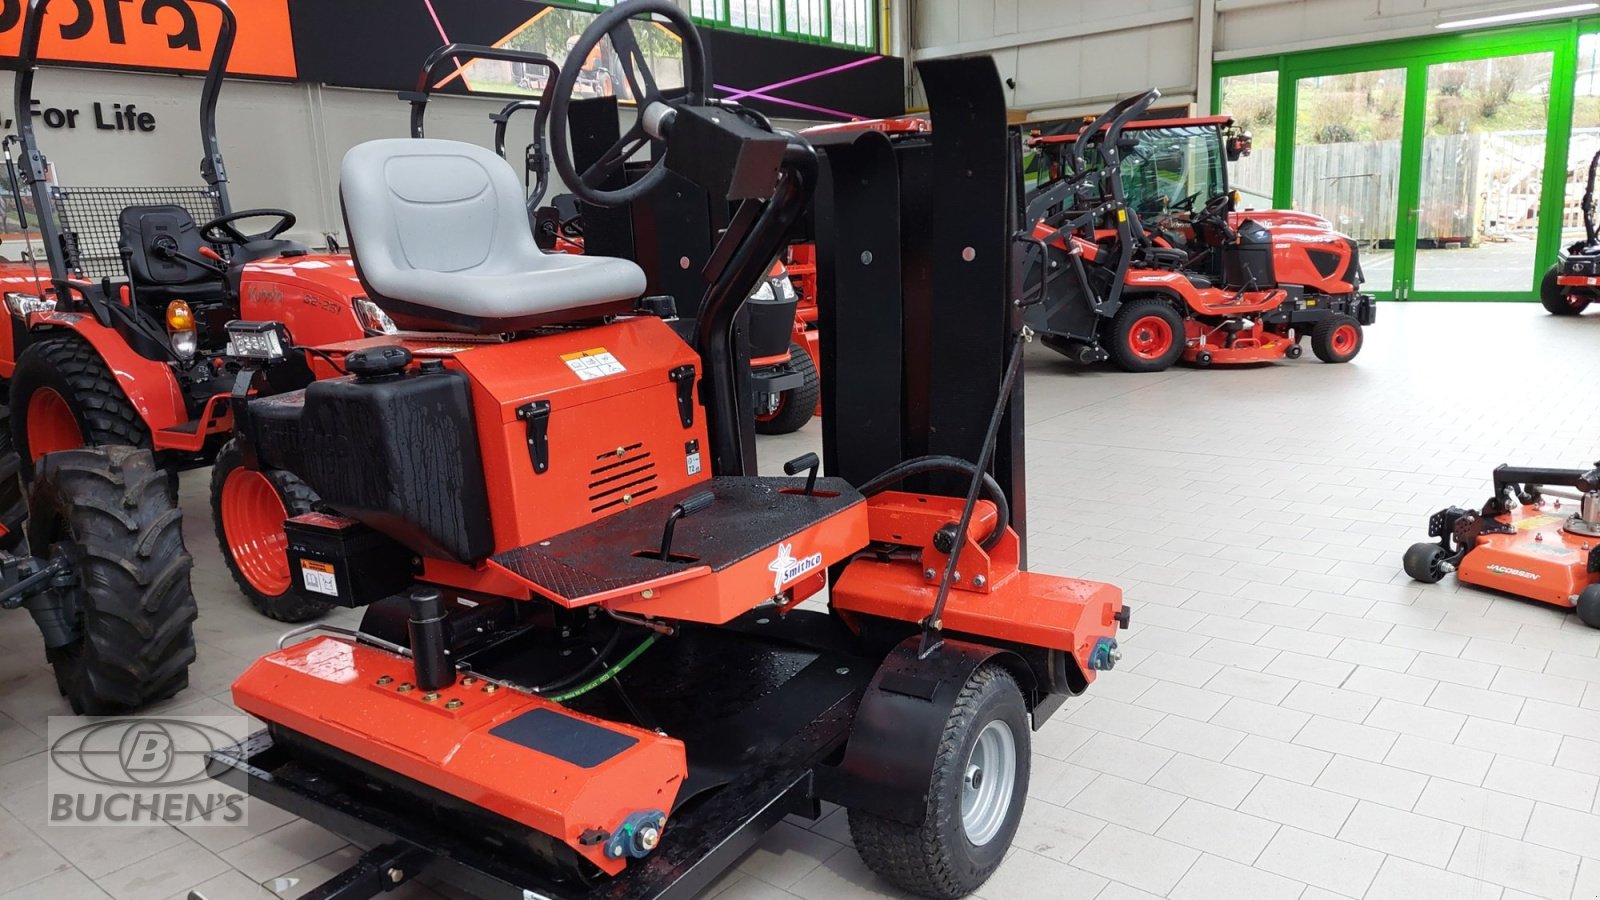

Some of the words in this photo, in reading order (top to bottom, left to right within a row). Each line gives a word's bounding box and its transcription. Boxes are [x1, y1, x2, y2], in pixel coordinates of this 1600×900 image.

[30, 100, 79, 129] For
[94, 102, 156, 131] Life
[784, 555, 821, 581] Smithco
[1486, 563, 1540, 580] JACOBSEN
